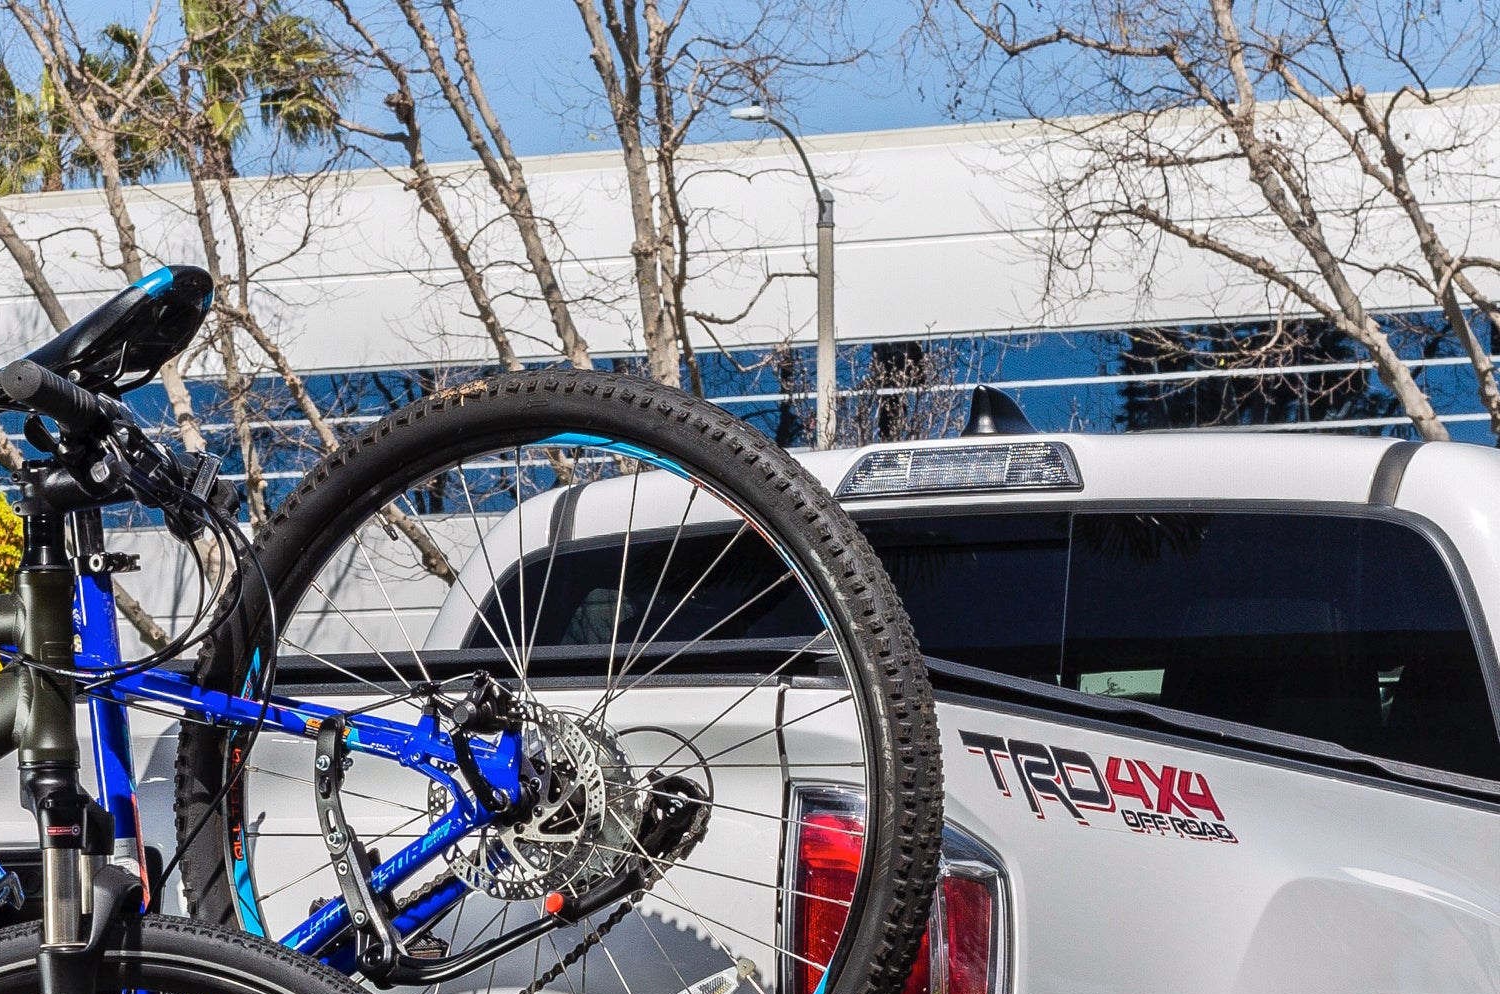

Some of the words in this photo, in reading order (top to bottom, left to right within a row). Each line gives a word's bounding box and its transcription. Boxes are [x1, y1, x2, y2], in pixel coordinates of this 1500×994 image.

[958, 729, 1116, 826] TRD
[1121, 809, 1172, 836] OFF
[1172, 817, 1238, 844] ROAD
